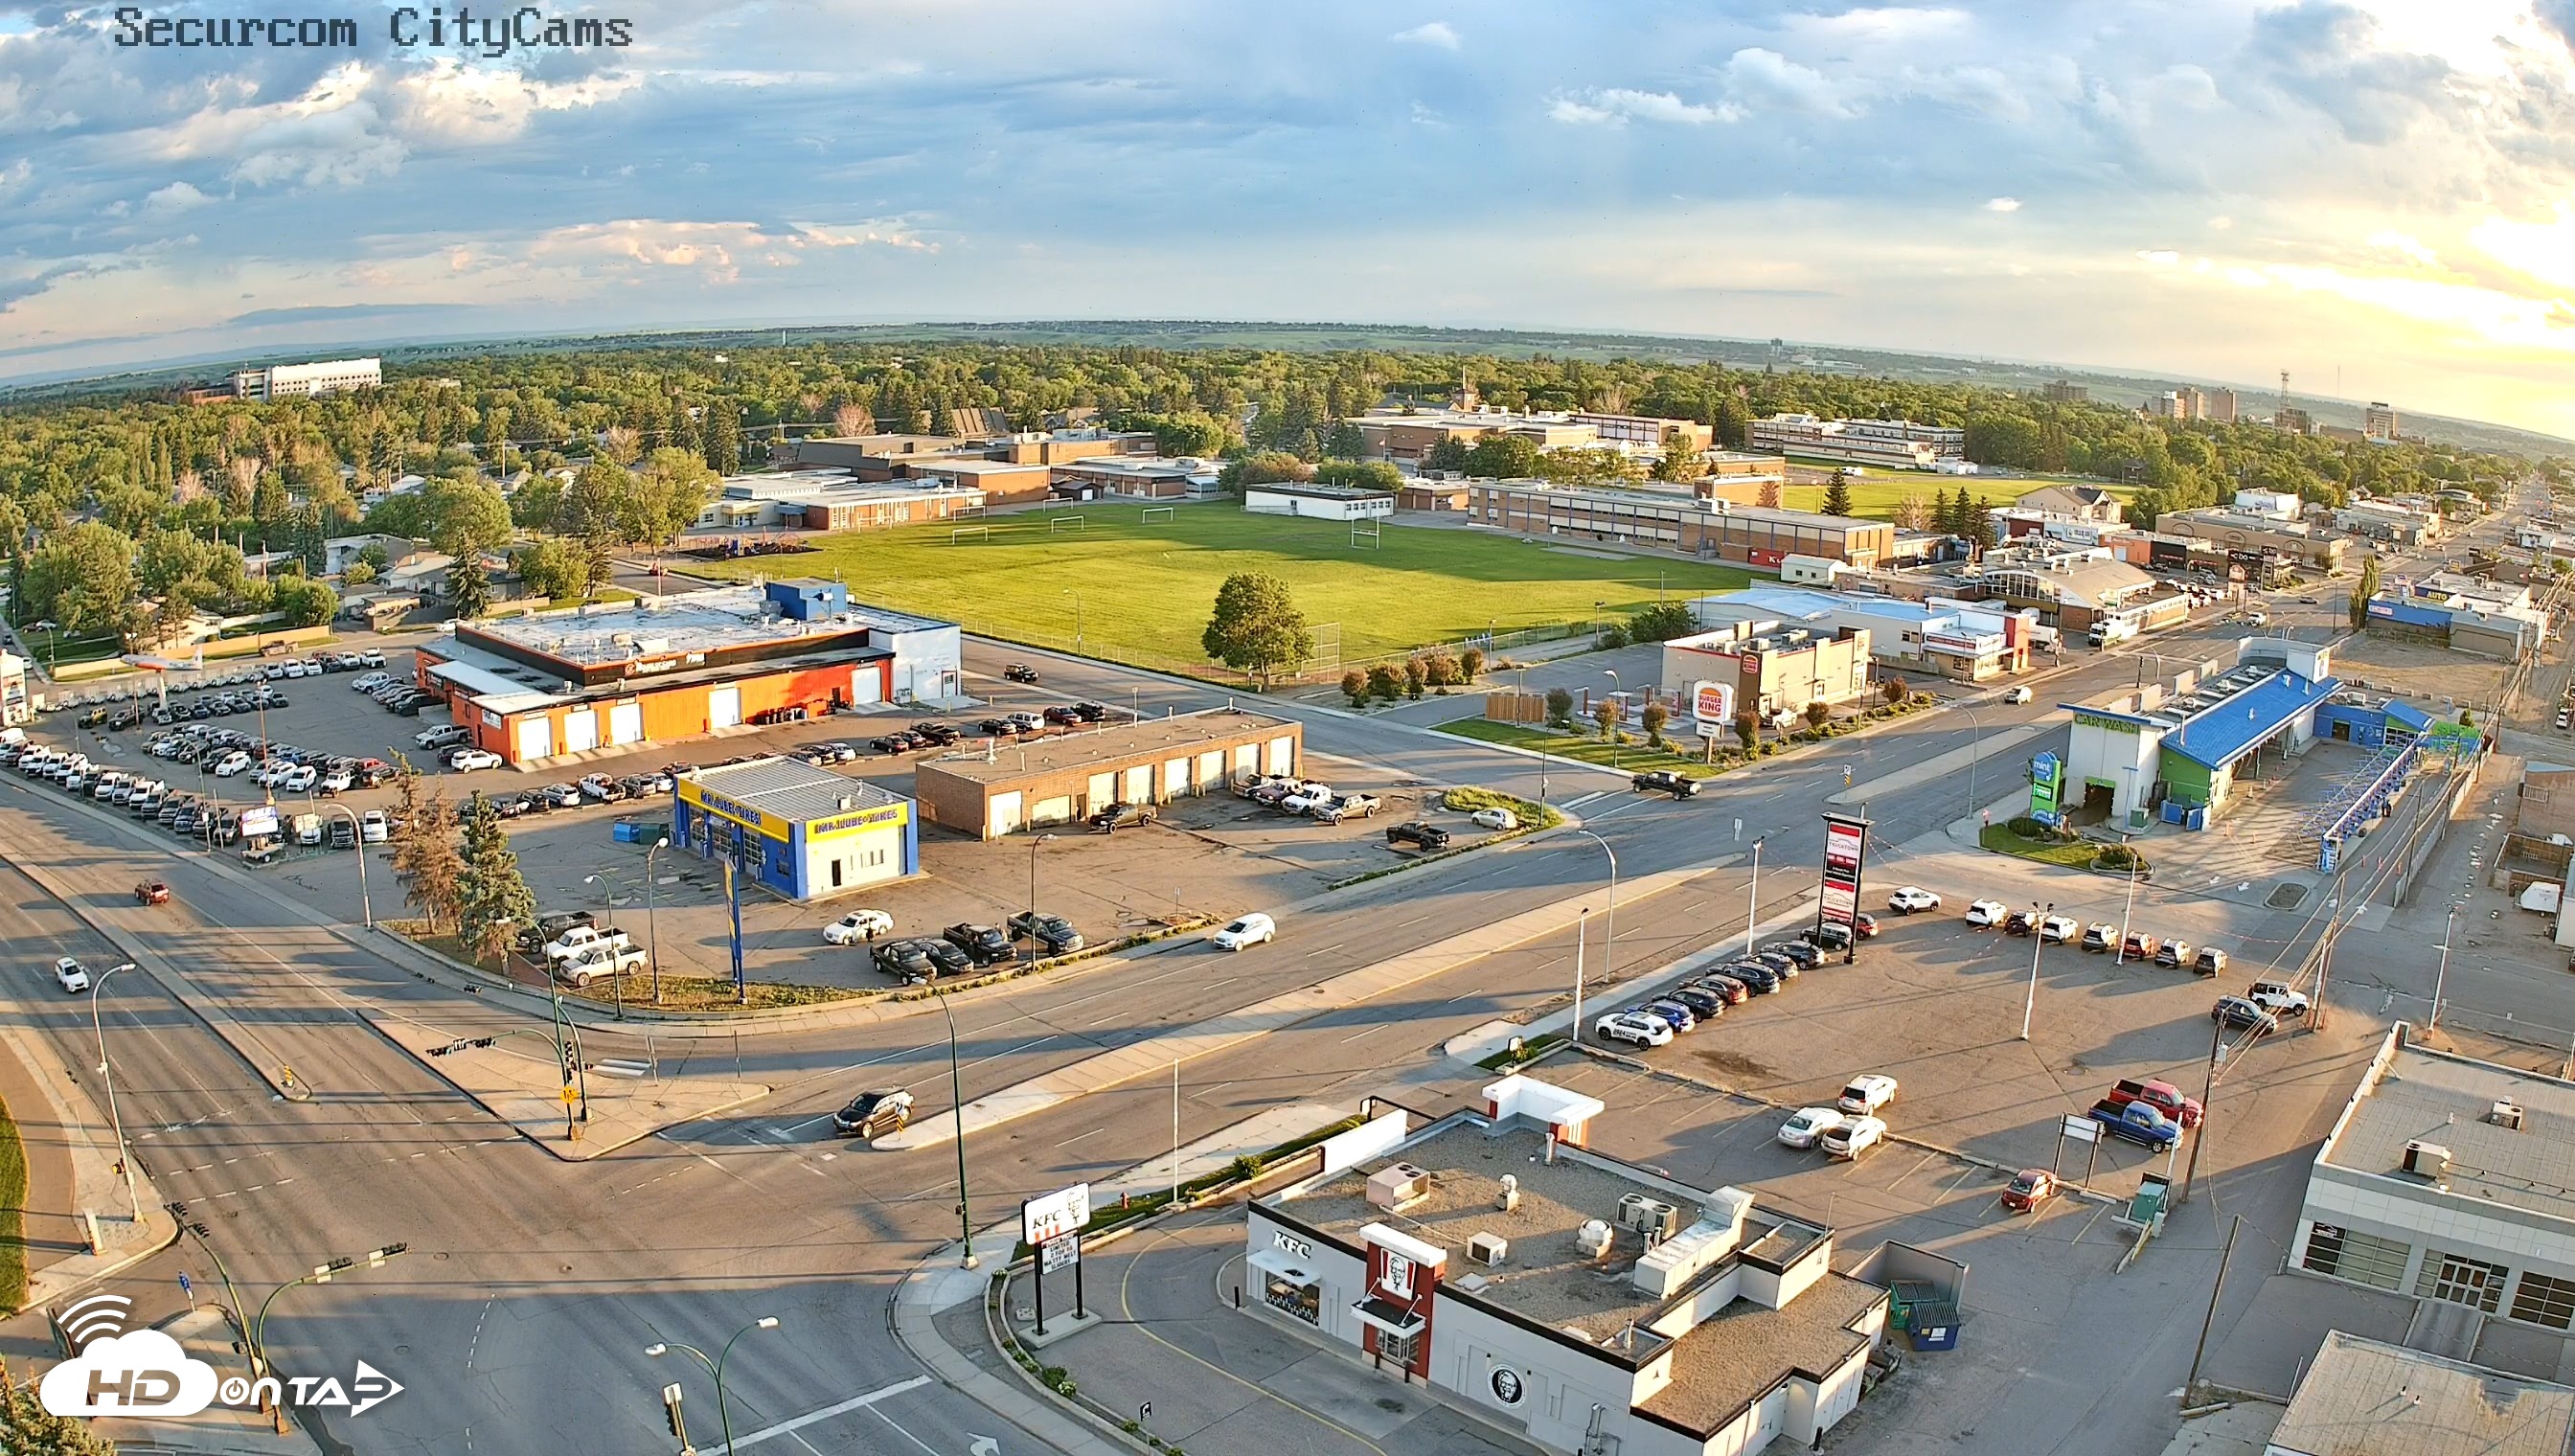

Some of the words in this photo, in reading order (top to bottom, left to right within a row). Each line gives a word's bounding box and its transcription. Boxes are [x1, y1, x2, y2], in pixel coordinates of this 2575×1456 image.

[2427, 591, 2448, 601] AUTO
[1698, 694, 1721, 704] BURGER
[1698, 701, 1721, 712] KING
[2074, 714, 2100, 728] CAR
[2101, 718, 2139, 736] WASH
[2034, 761, 2050, 771] mint
[1033, 1209, 1061, 1230] KFC
[1273, 1231, 1312, 1259] KFC
